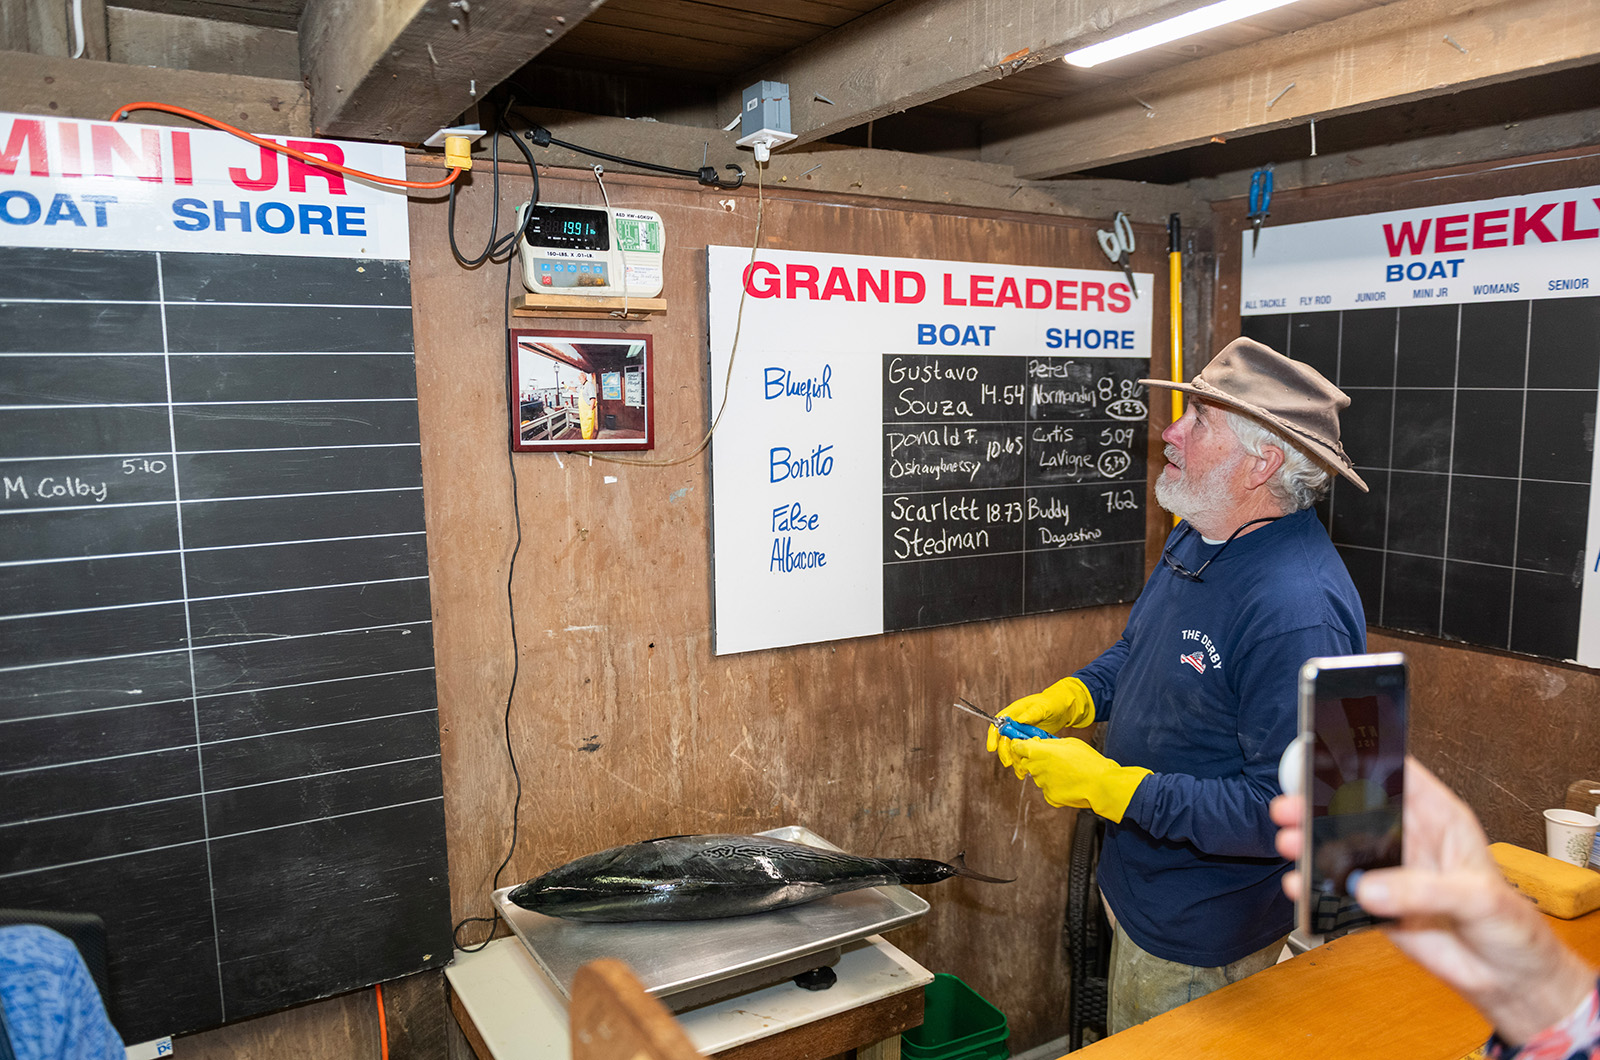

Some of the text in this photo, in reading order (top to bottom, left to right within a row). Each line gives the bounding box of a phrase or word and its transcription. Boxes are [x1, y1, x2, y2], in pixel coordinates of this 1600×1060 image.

[0, 118, 348, 196] MINI JR
[0, 190, 118, 228] OAT
[172, 198, 367, 237] SHORE
[1382, 197, 1600, 258] WEEKL
[1386, 258, 1464, 283] BOAT
[742, 261, 1132, 314] GRAND LEADERS
[1355, 291, 1386, 303] JUNIOR
[1413, 288, 1448, 299] MINI JR
[1473, 282, 1520, 295] WOMANS
[1548, 278, 1590, 291] SENIOR
[1245, 298, 1286, 309] ALL TACKLE
[1300, 295, 1332, 305] FLY ROD
[917, 324, 996, 347] BOAT
[1046, 328, 1134, 349] SHORE
[889, 357, 978, 384] Gustavo
[1029, 357, 1074, 378] Peter
[764, 364, 832, 412] Bluefish
[981, 383, 1025, 405] 14.54
[894, 387, 973, 416] Souza
[886, 425, 961, 457] Donald
[986, 436, 1023, 461] 10.65
[770, 444, 833, 483] Bonito
[38, 476, 107, 502] Colby
[1100, 489, 1138, 513] 7.62
[772, 502, 819, 532] False
[891, 496, 980, 522] Scarlett
[986, 502, 1023, 523] 18.73
[1027, 497, 1069, 526] Buddy
[770, 537, 827, 573] Albacore
[894, 527, 989, 559] Stedman
[1181, 629, 1222, 669] THE DERBY
